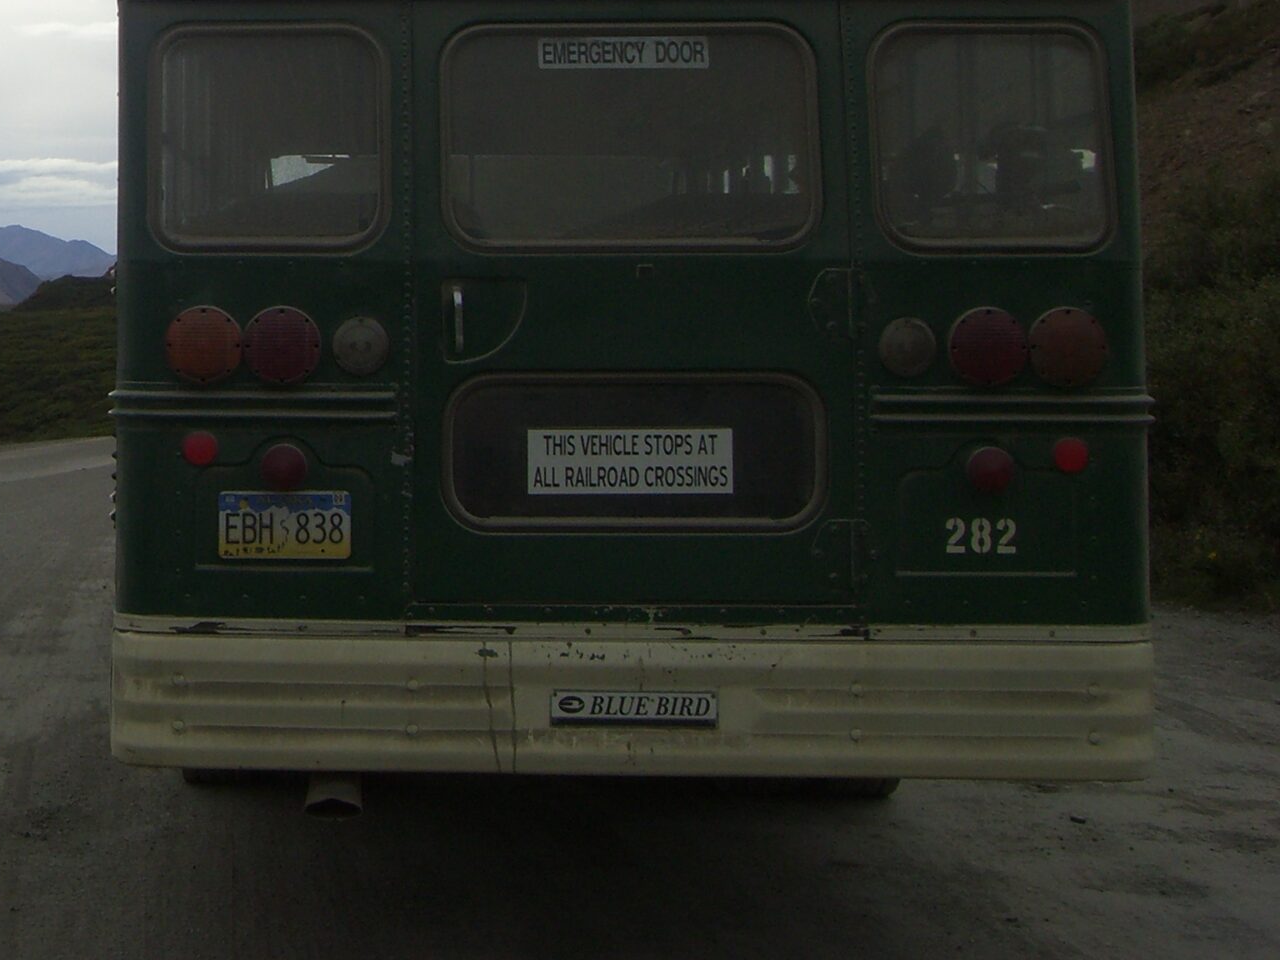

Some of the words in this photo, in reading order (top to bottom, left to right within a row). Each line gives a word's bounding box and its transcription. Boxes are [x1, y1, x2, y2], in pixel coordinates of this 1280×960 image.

[542, 41, 646, 65] EMERGENCY
[655, 41, 705, 64] DOOR
[543, 435, 576, 456] THIS
[580, 435, 639, 456] VEHICLE
[644, 434, 693, 456] STOPS
[698, 434, 718, 455] AT
[533, 466, 560, 487] ALL
[565, 466, 640, 487] RAILROAD
[644, 466, 729, 488] CROSSINGS
[225, 512, 274, 545] EBH
[295, 512, 344, 545] 838
[945, 516, 1017, 555] 282
[590, 695, 651, 716] BLUE
[655, 696, 711, 717] BIRD
